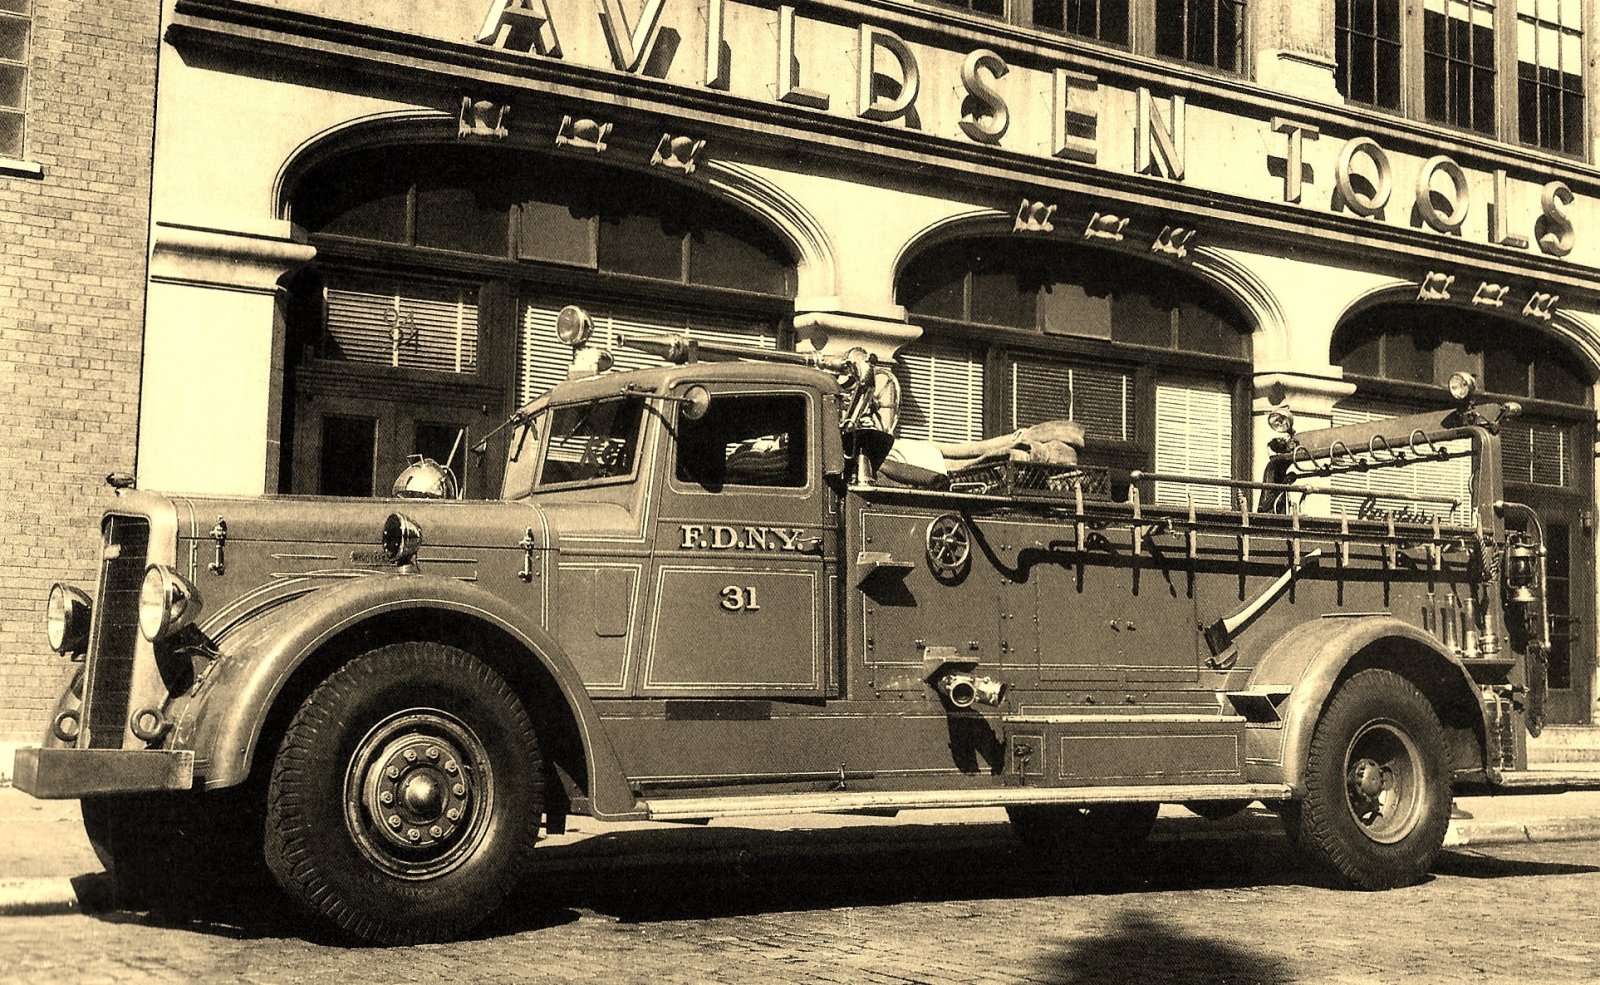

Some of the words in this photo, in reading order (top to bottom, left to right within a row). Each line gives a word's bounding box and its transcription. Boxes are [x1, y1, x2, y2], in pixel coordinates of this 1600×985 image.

[475, 0, 1186, 180] AVILDSEN
[1269, 117, 1576, 257] TOOLS
[681, 524, 804, 550] F.D.N.Y.
[721, 585, 761, 610] 31
